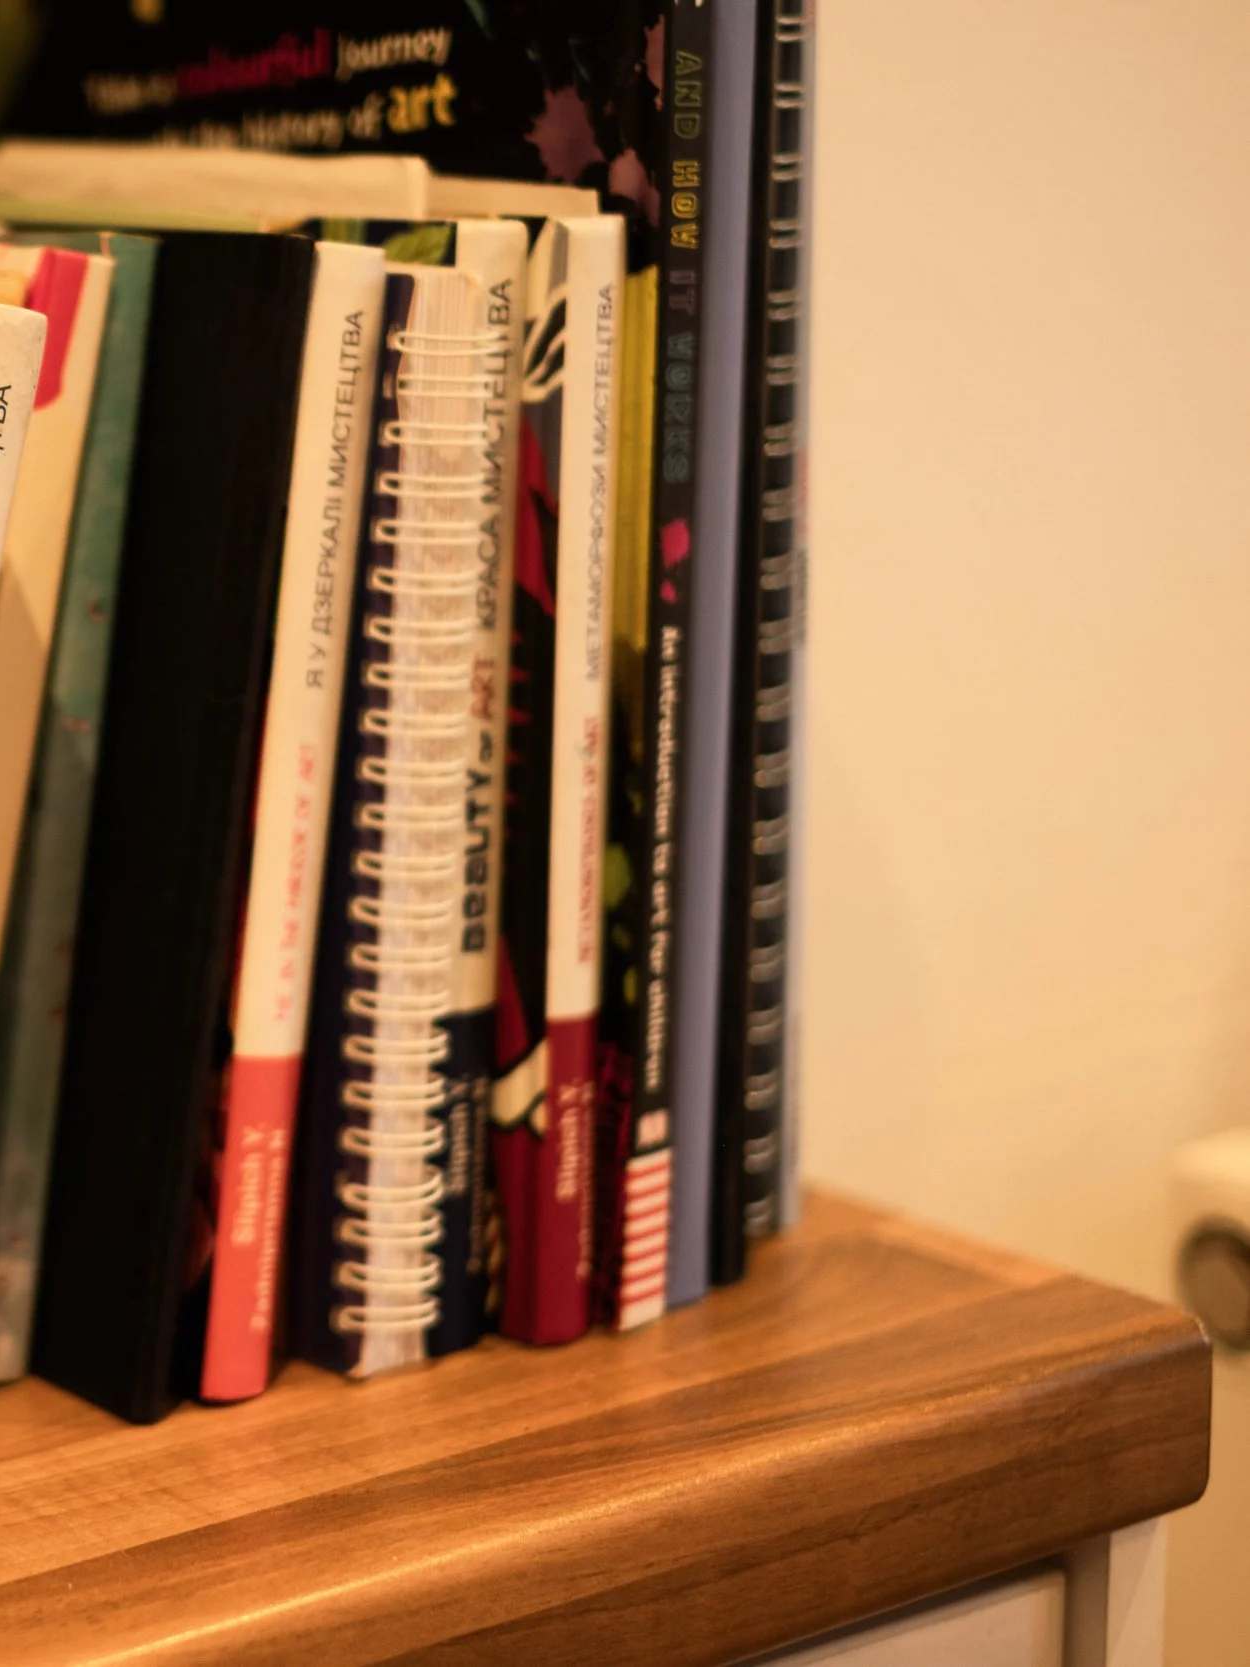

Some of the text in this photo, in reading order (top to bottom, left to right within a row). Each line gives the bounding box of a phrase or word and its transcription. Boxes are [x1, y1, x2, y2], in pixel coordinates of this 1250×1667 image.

[335, 27, 451, 81] journey
[387, 72, 458, 134] art
[663, 49, 703, 484] AND HOW IT WORKS
[312, 496, 344, 638] ДЗЕРКАЛІ
[333, 309, 365, 491] МИСТЕЦТВА
[475, 513, 505, 630] КРАСА
